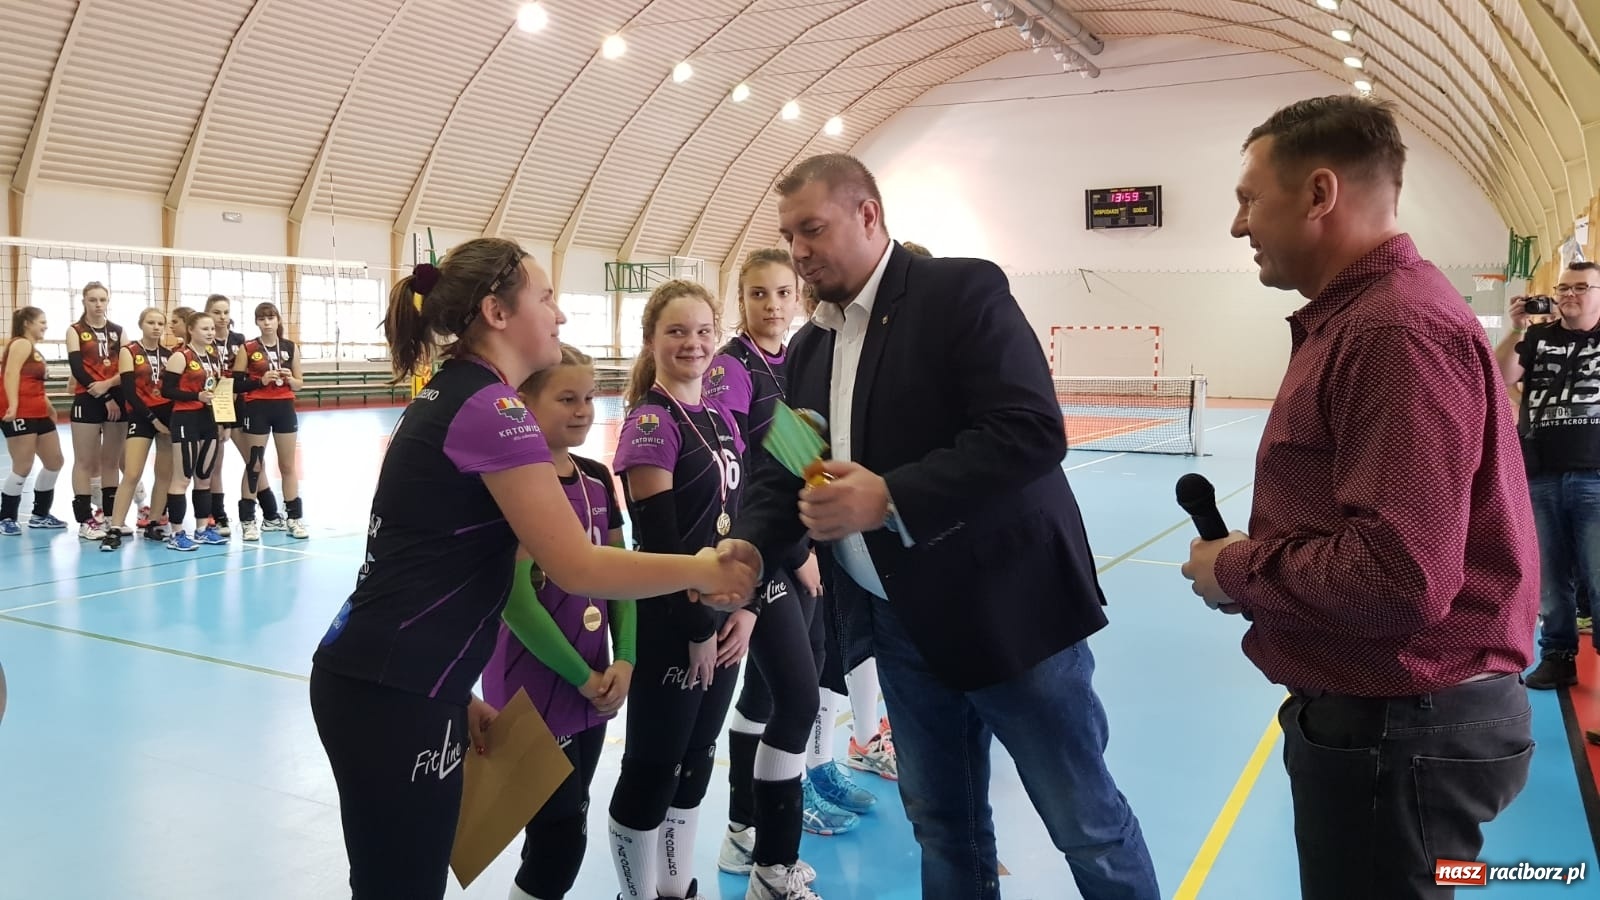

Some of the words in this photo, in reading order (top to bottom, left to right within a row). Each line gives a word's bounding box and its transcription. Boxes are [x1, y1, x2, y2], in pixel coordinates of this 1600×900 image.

[1111, 192, 1139, 202] 13:59
[13, 418, 27, 432] 12
[412, 719, 462, 783] FitLine
